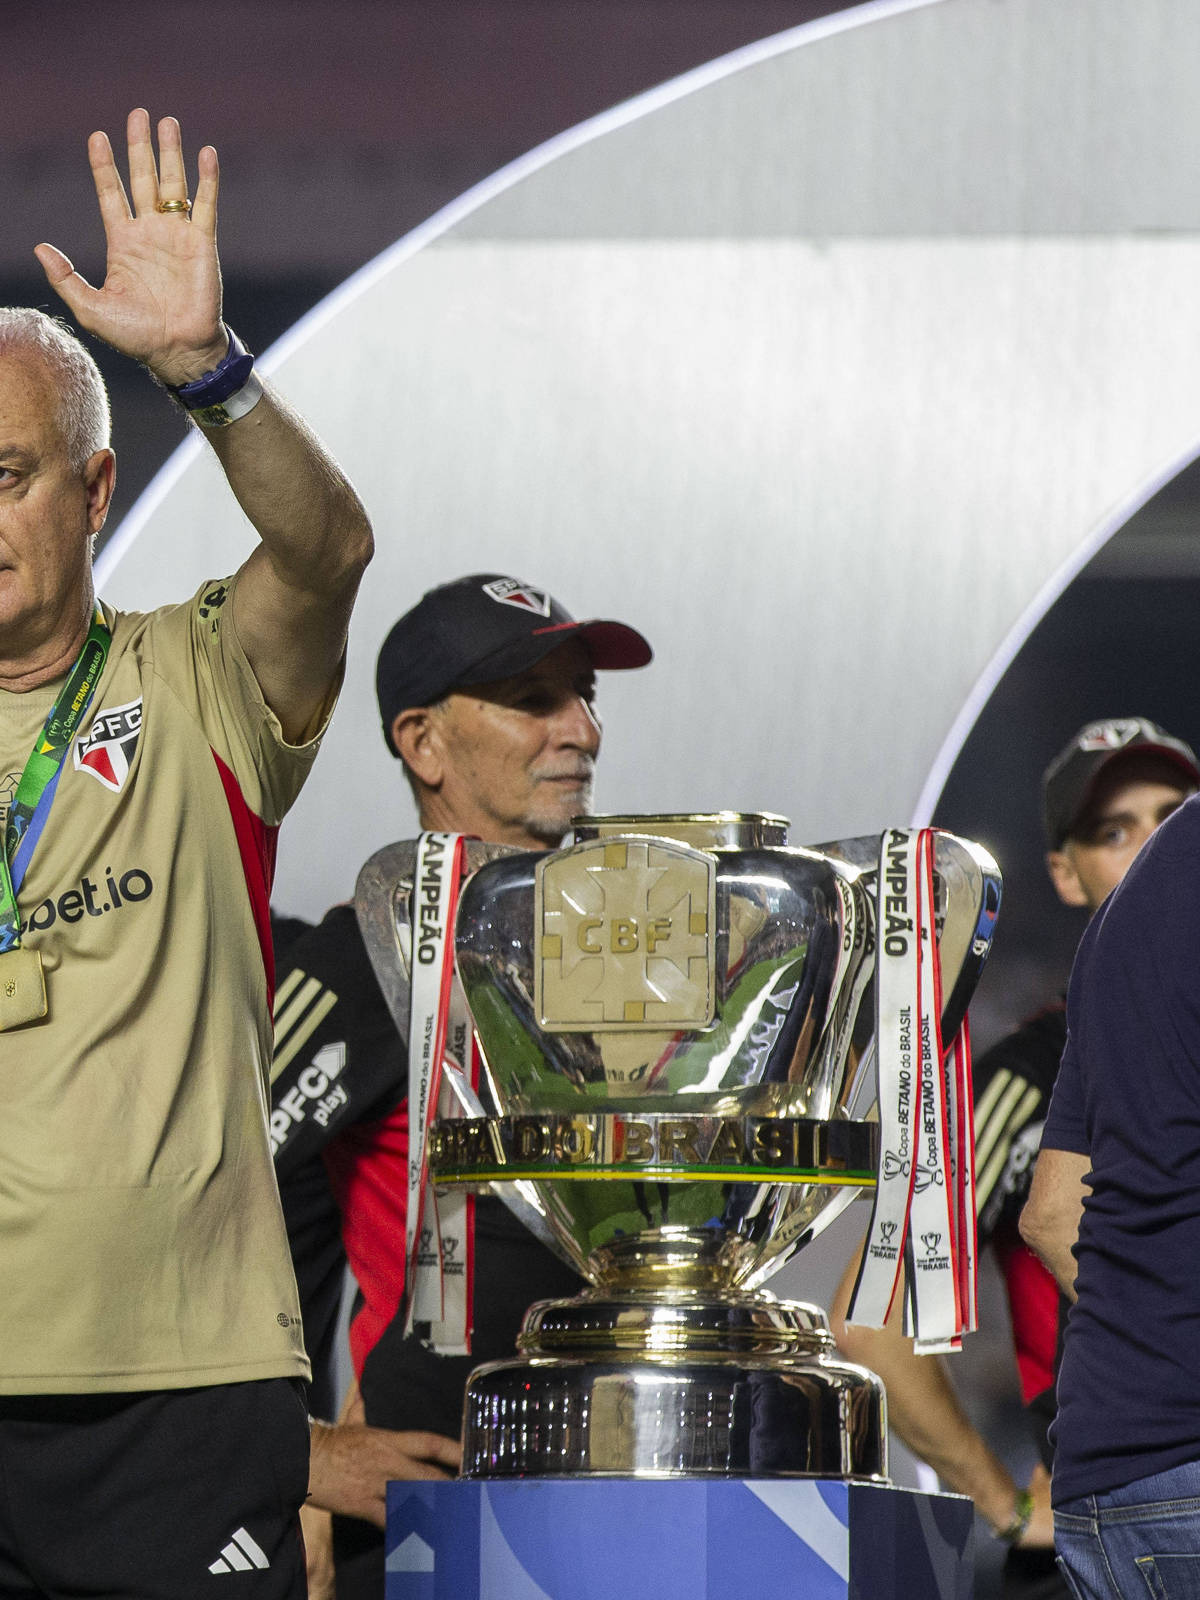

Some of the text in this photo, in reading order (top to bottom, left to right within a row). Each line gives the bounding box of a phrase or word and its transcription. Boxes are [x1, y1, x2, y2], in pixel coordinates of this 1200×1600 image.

[71, 681, 91, 712] BETANO
[89, 650, 103, 675] BRASIL
[418, 834, 448, 965] AMPEÃO
[884, 829, 913, 957] AMPEÃO
[577, 918, 672, 953] CBF
[422, 1014, 434, 1059] BRASIL
[312, 1084, 348, 1127] play
[898, 1005, 912, 1158] Copa BETANO do BRASIL
[921, 1013, 938, 1168] Copa BETANO do BRASIL
[623, 1120, 848, 1168] BRASIL
